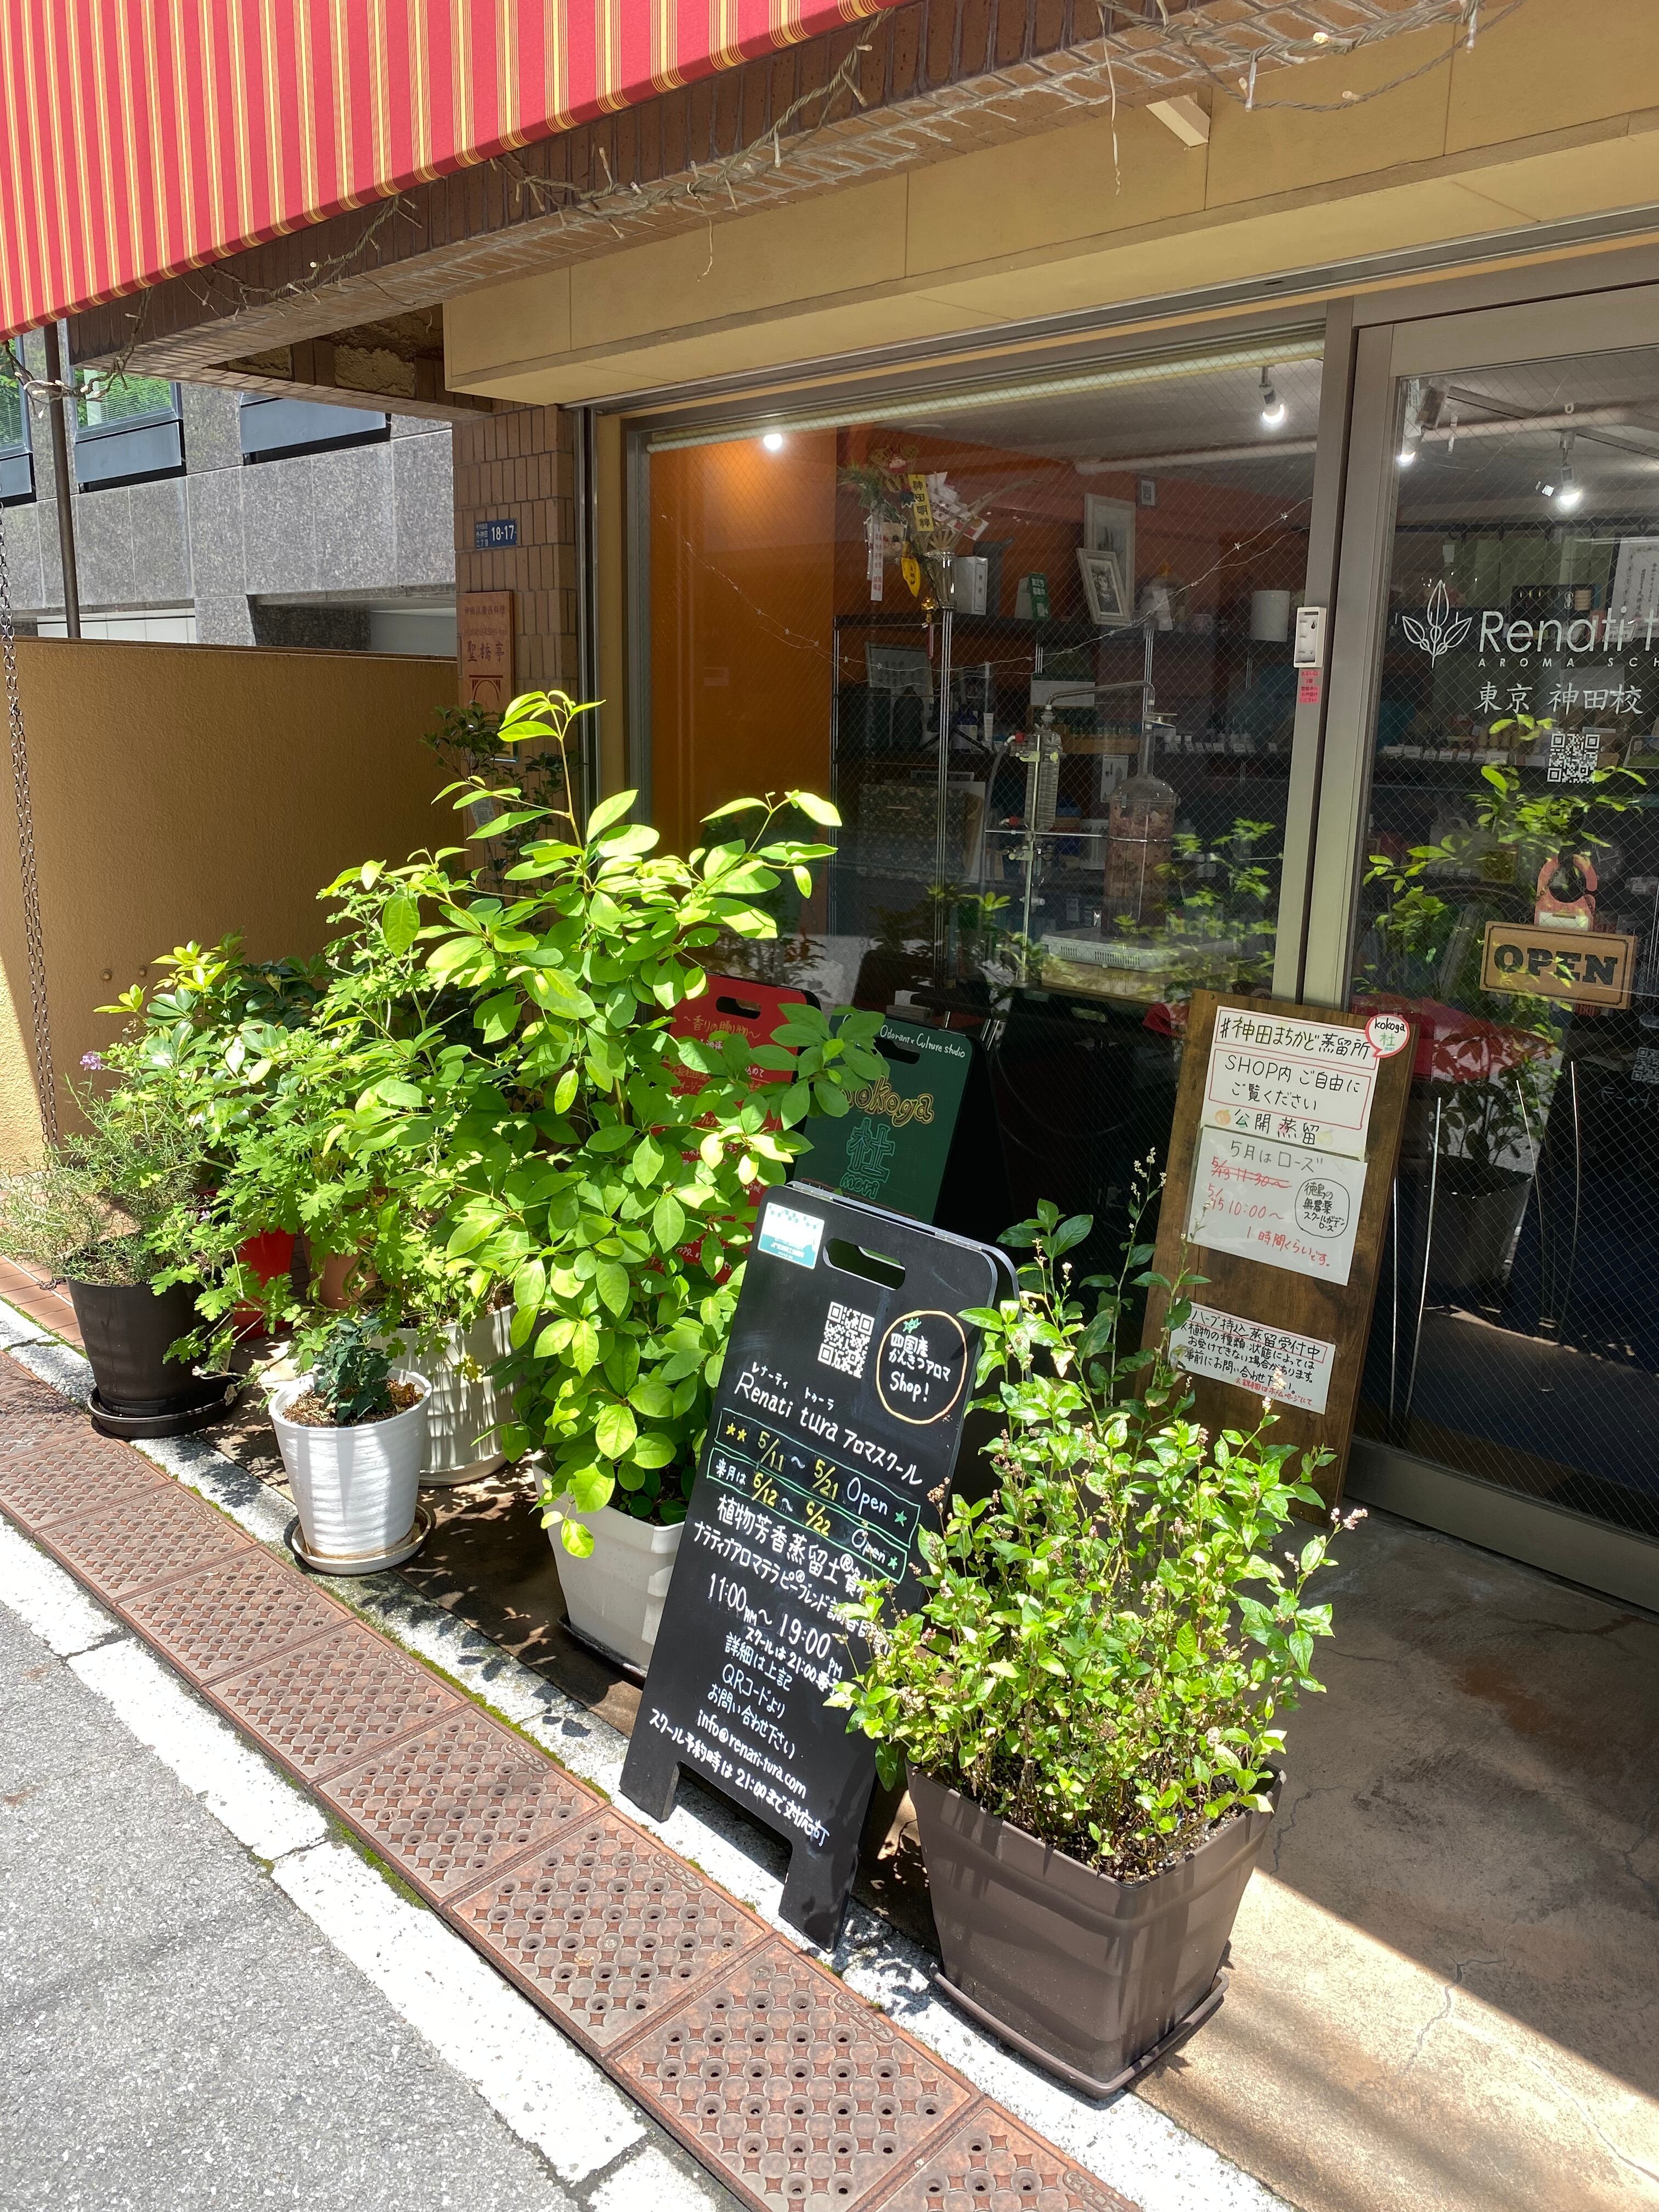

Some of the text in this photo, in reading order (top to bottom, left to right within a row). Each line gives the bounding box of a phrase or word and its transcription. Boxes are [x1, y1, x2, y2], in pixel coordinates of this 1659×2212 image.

[492, 525, 515, 541] 18-17
[1479, 605, 1628, 653] Renati
[467, 640, 505, 662] 聖橋亭
[1478, 657, 1575, 668] AROMA
[1474, 681, 1644, 715] 東京 神田校
[1493, 944, 1618, 986] OPEN
[1374, 1018, 1406, 1034] kokoga
[944, 1045, 966, 1058] studio
[1232, 1081, 1317, 1110] ご覧ください
[839, 1172, 881, 1200] mori
[1304, 1181, 1334, 1200] 徳島の
[1302, 1197, 1333, 1215] 無農薬
[1318, 1221, 1338, 1232] ローズ
[890, 1333, 929, 1358] 四国産
[751, 1361, 789, 1389] レナーティ
[888, 1347, 951, 1382] かんきつアロマ
[734, 1371, 923, 1485] Renati tura アロマスクール
[757, 1430, 785, 1472] 5/11
[812, 1458, 839, 1501] 5/21
[847, 1477, 889, 1516] Open
[715, 1458, 747, 1486] 来月は
[805, 1500, 832, 1537] 6/22
[851, 1528, 886, 1564] Open
[724, 1630, 793, 1692] 詳細は上記
[722, 1663, 786, 1719] QRコードより
[696, 1708, 807, 1799] info@renati-tura.com
[839, 1995, 891, 2039] キャスコーナー
